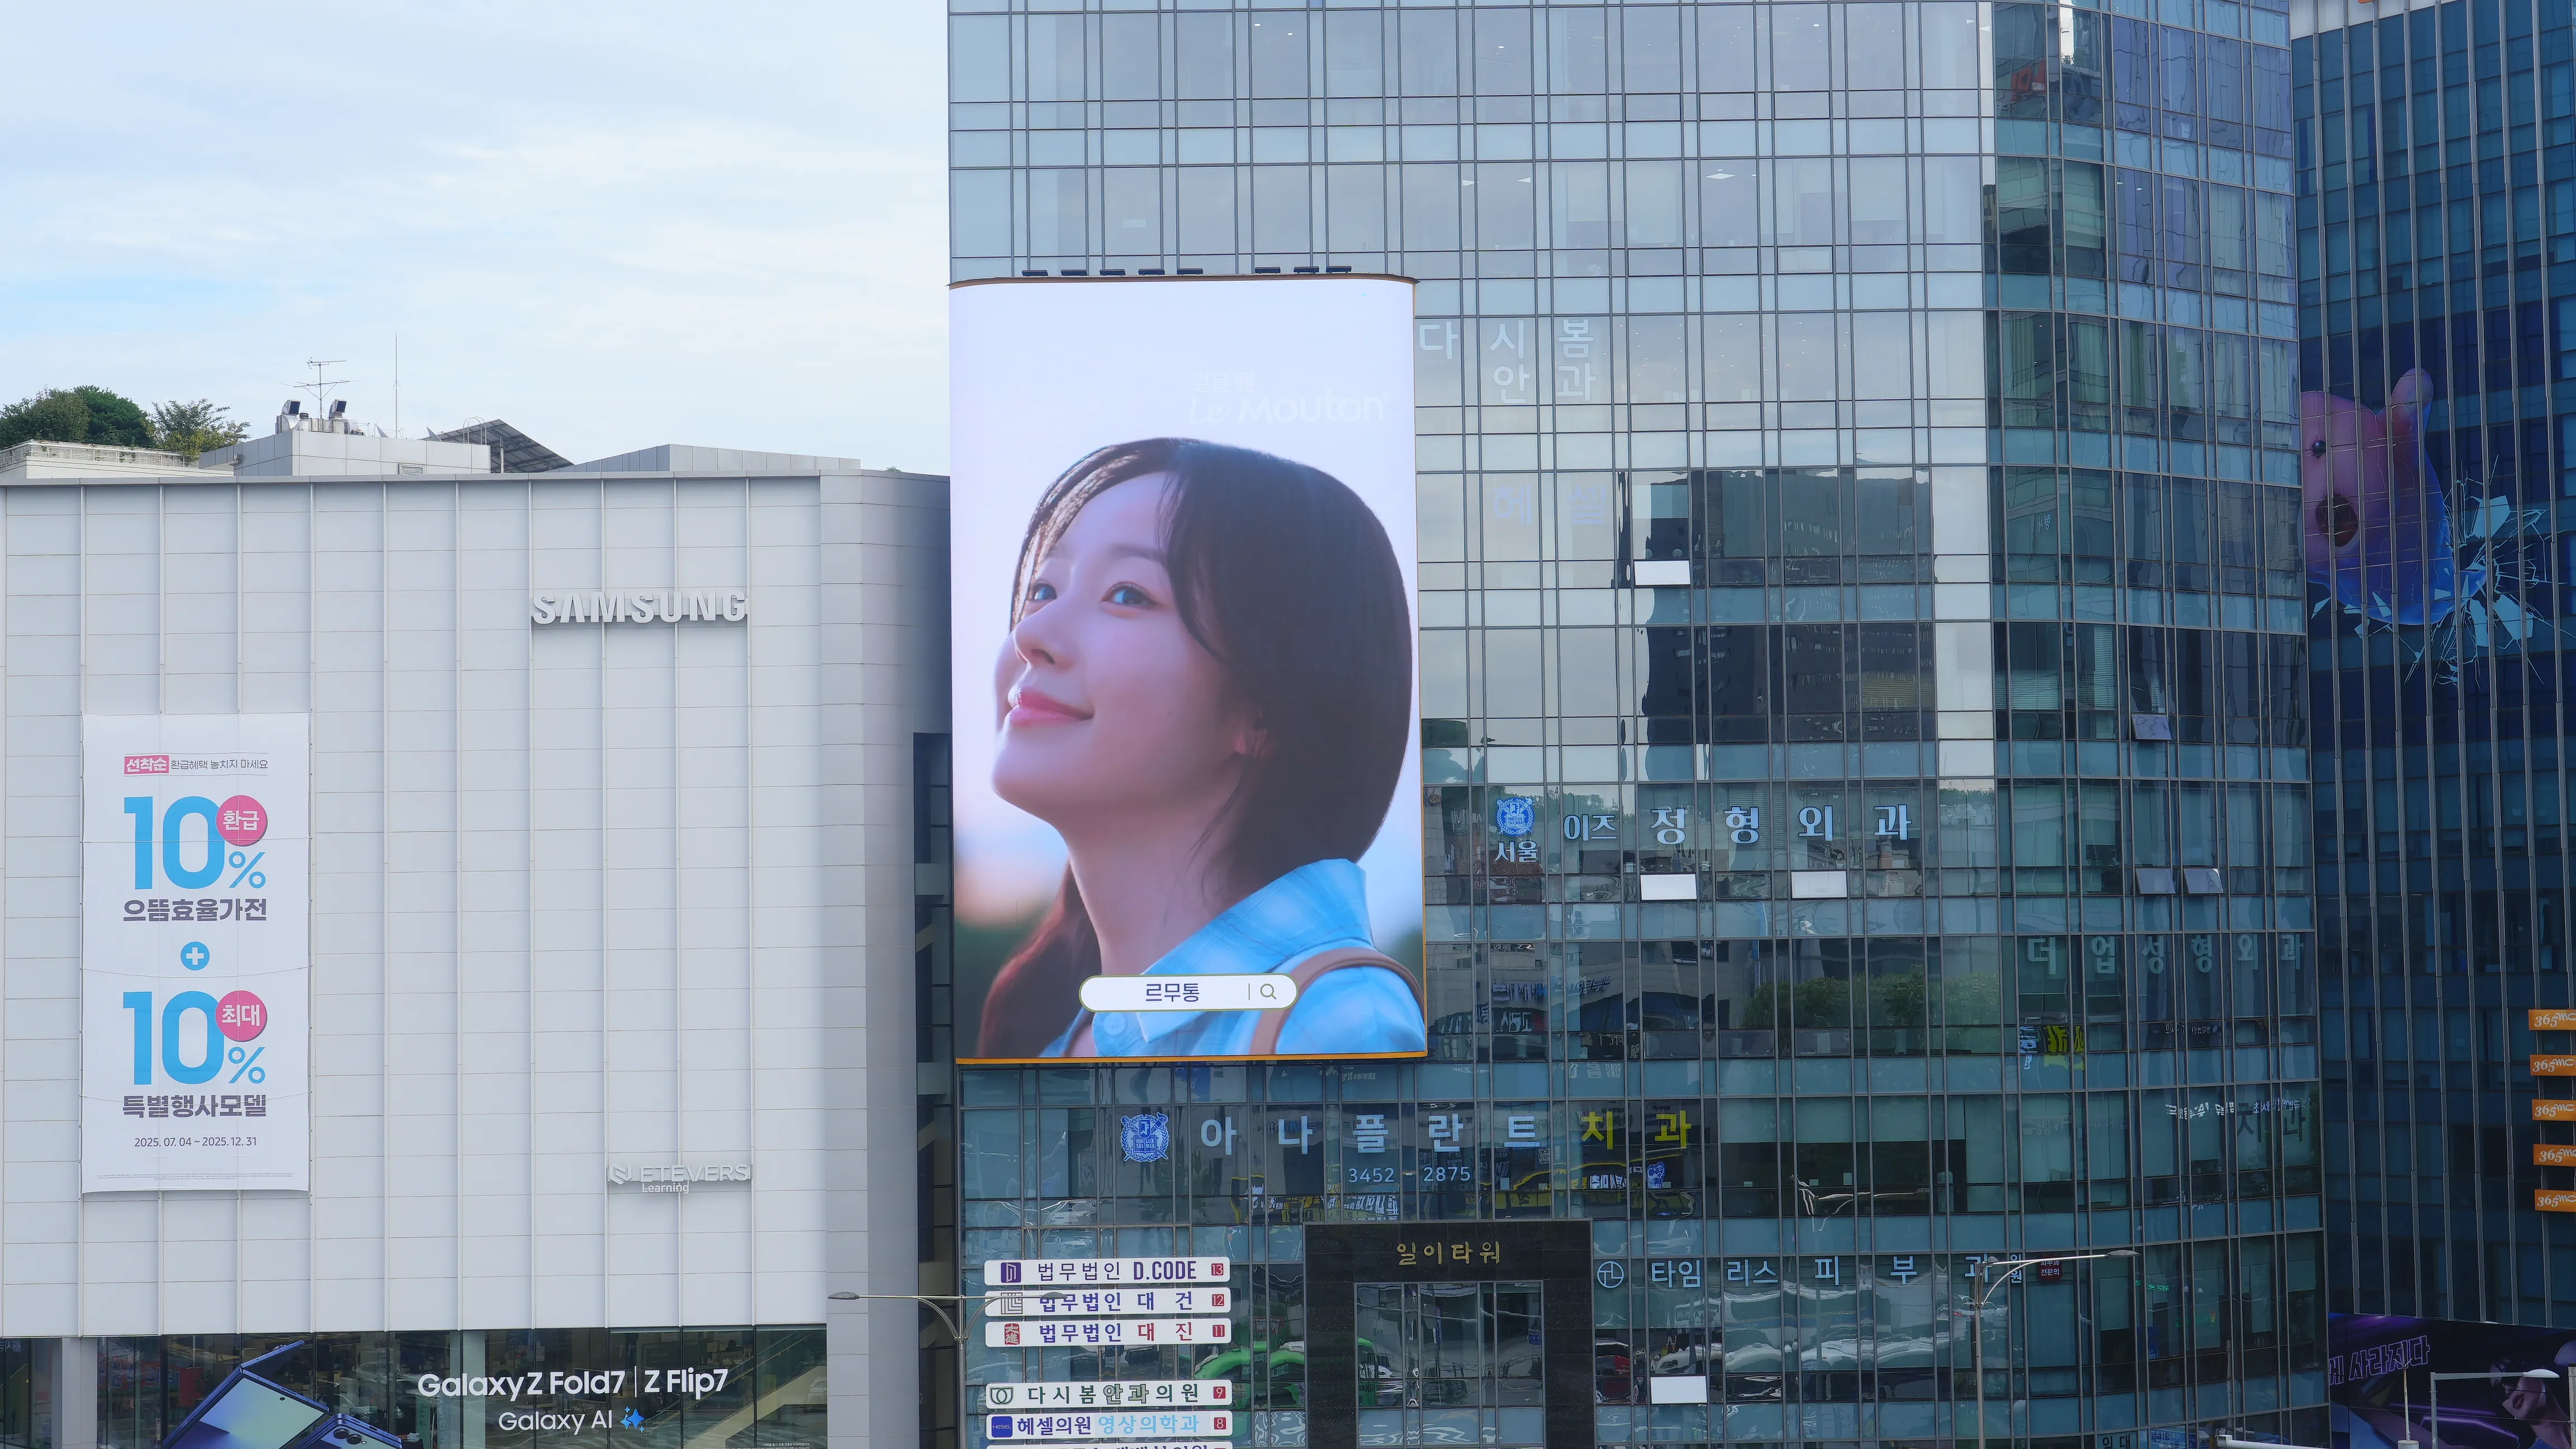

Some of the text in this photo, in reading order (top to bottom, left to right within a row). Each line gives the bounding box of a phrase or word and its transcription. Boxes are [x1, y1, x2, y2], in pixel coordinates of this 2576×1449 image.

[1493, 362, 1597, 404] 안과
[532, 590, 746, 624] SAMSUNG
[126, 757, 268, 772] 선착순 환급혜택 놓치지 마세요
[222, 810, 260, 831] 환급
[1563, 804, 1912, 845] 이즈 정형외과
[1494, 840, 1538, 863] 서울
[124, 898, 267, 921] 으뜸효율가전
[1145, 983, 1200, 1002] 르무통
[221, 1005, 261, 1027] 최대
[122, 1094, 267, 1118] 특별행사모델
[640, 1164, 749, 1182] ETEVERS
[642, 1182, 690, 1195] Learning
[1396, 1240, 1500, 1266] 일이타워
[1038, 1261, 1223, 1281] 법무법인 D.CODE 13
[2041, 1268, 2060, 1276] 전문의
[1039, 1291, 1121, 1313] 법무법인
[1213, 1295, 1224, 1305] 12
[1039, 1323, 1121, 1343] 법무법인
[1214, 1325, 1224, 1336] 11
[2348, 1335, 2430, 1381] 사라지다
[550, 1369, 626, 1394] Fold7
[644, 1370, 660, 1393] Z
[667, 1367, 728, 1400] Flip7
[1216, 1388, 1224, 1398] 9
[499, 1410, 613, 1436] Galaxy AI
[1017, 1415, 1224, 1436] 헤셀의원 영상의학과 8
